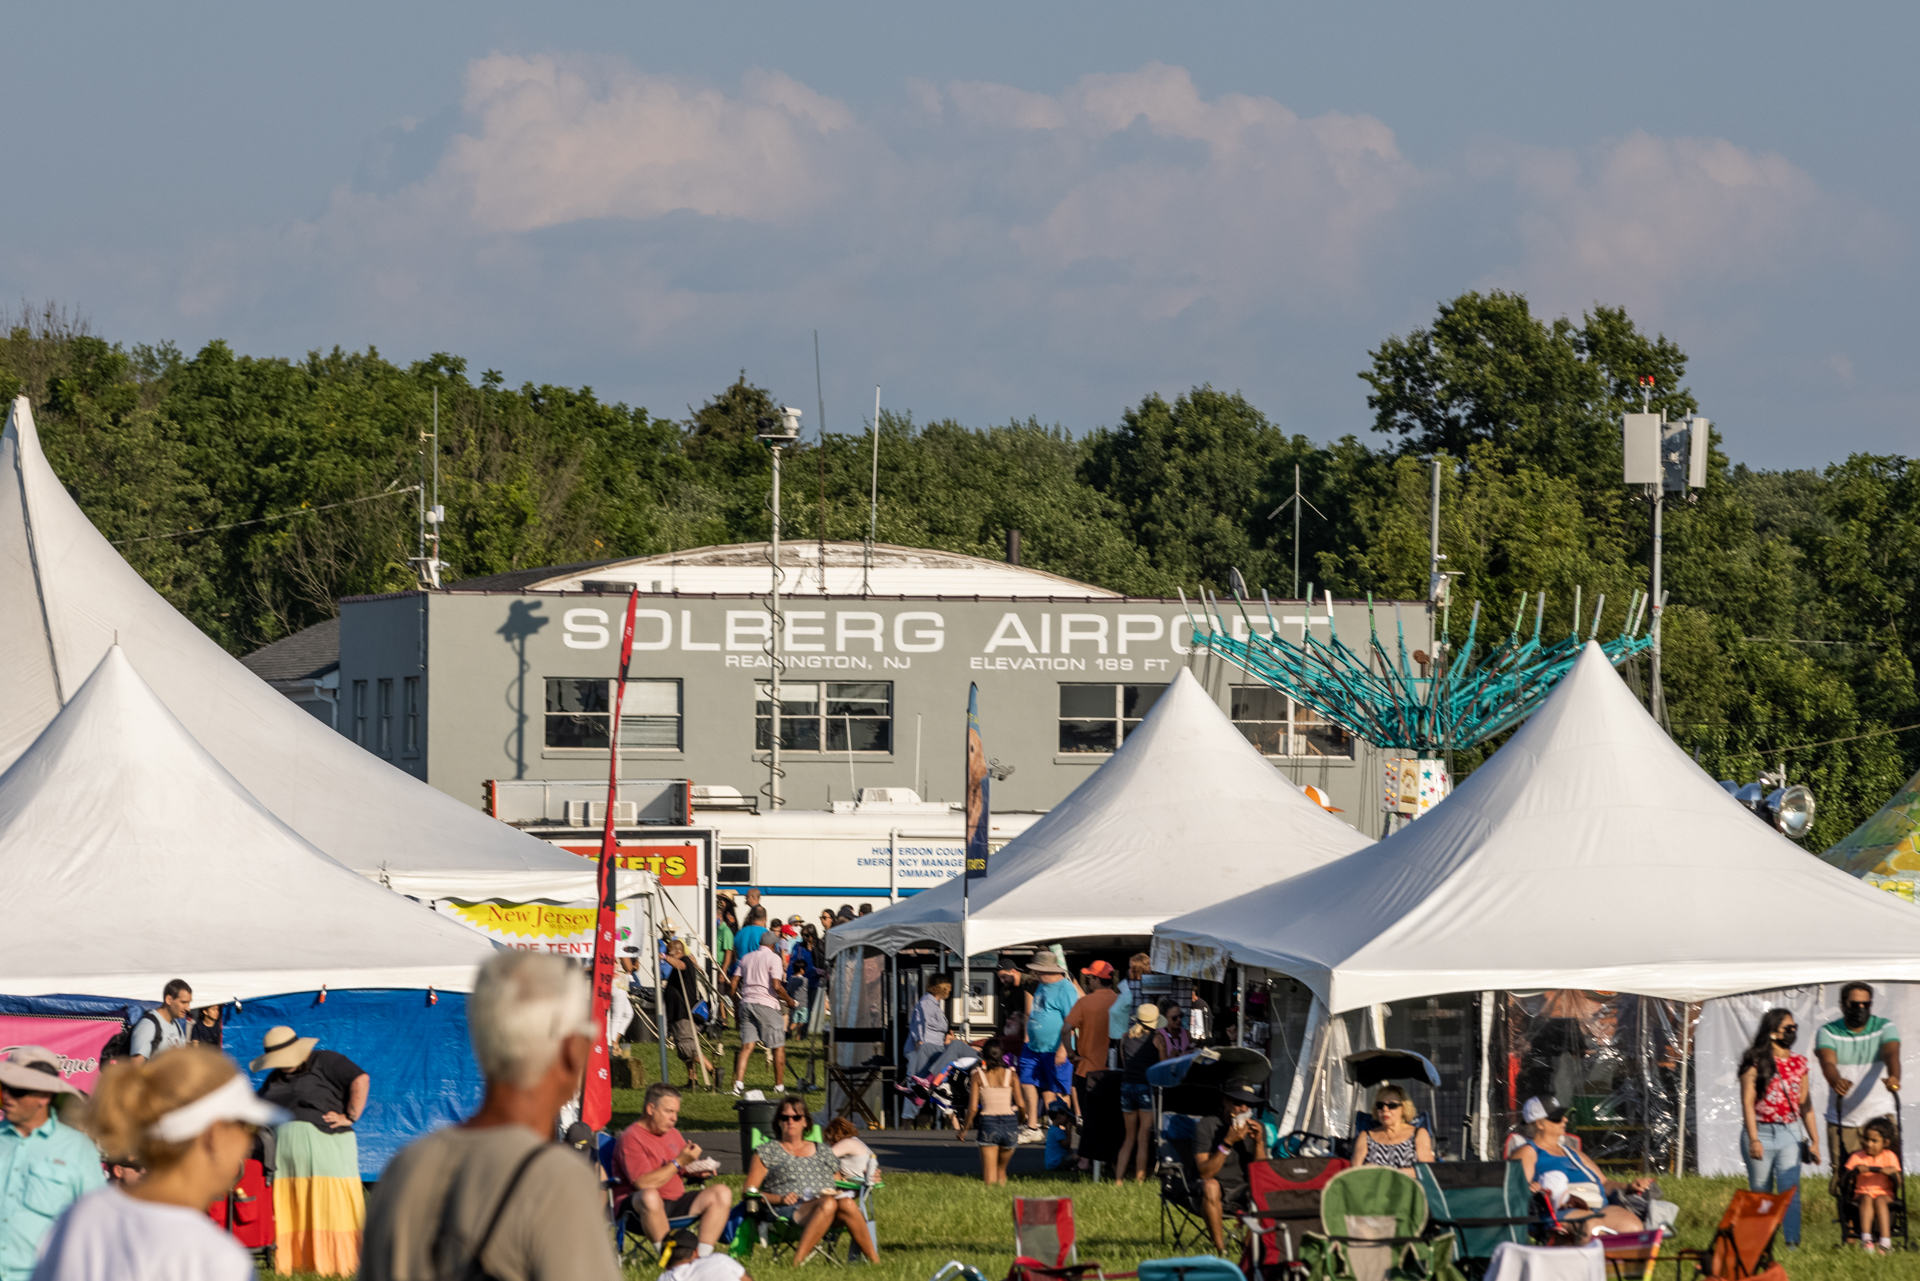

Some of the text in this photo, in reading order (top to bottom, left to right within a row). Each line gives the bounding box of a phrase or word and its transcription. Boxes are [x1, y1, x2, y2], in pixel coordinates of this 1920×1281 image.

[562, 608, 1331, 657] SOLBERG AIRPORT
[883, 656, 912, 669] NJ
[970, 657, 1170, 671] ELEVATION 189 FT
[872, 847, 966, 856] HUNERDON COUN
[857, 858, 919, 867] EMERGNCY
[921, 858, 965, 867] MANAGE
[896, 869, 943, 878] OMMAND
[487, 904, 593, 928] New Jersey
[546, 942, 594, 954] TENT
